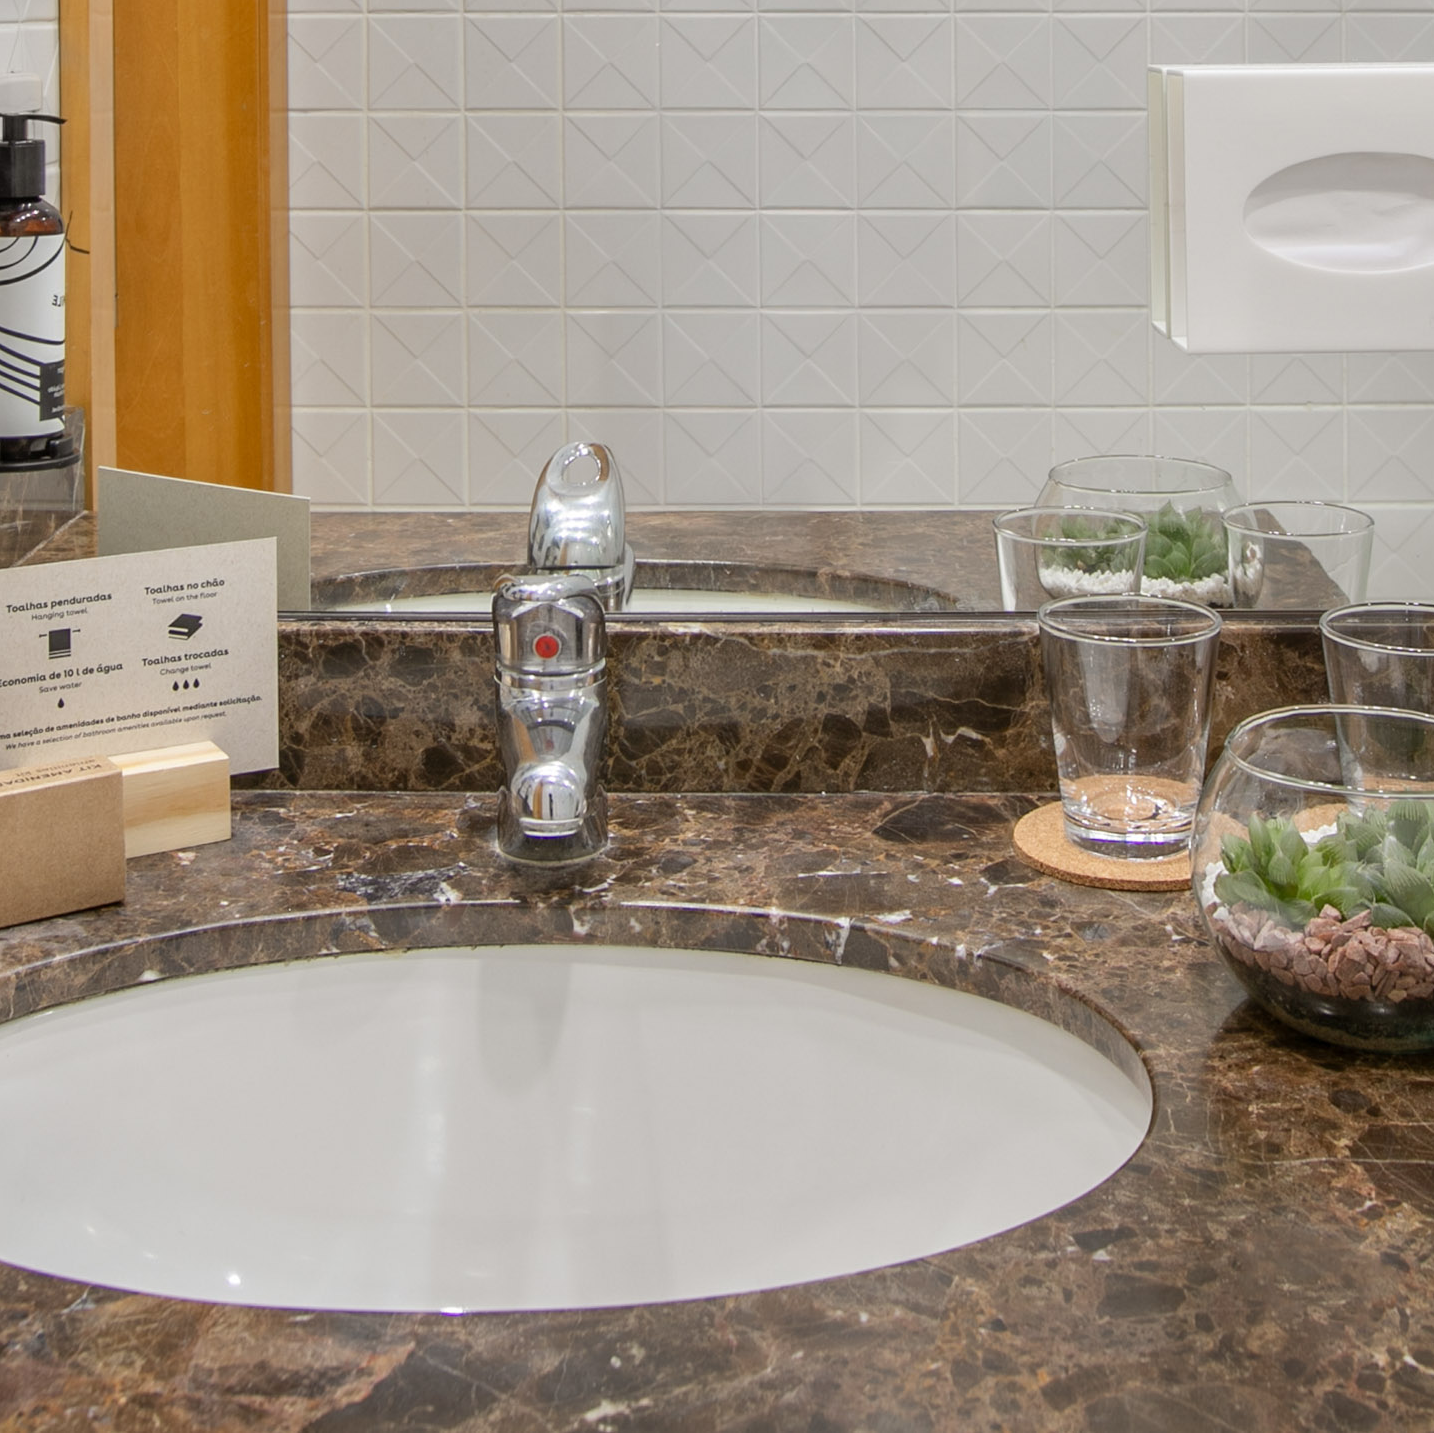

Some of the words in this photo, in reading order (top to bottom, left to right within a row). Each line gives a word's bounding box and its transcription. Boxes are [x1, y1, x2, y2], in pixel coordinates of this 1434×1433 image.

[144, 584, 184, 595] Toalhas
[186, 582, 199, 590] no
[200, 578, 225, 588] chão
[6, 601, 48, 613] Toalhas
[50, 593, 112, 609] penduradas
[152, 596, 174, 605] Towel
[31, 611, 65, 620] Hanging
[66, 607, 88, 616] towel
[142, 655, 182, 666] Toalhas
[184, 649, 229, 661] trocadas
[49, 671, 62, 680] de
[63, 669, 74, 678] 10
[82, 666, 94, 675] de
[96, 663, 123, 674] água
[160, 666, 189, 676] Change
[39, 685, 57, 693] Save
[59, 682, 82, 690] water
[13, 727, 44, 738] seleção
[45, 725, 55, 733] de
[56, 718, 104, 731] amenidades
[105, 716, 115, 724] de
[116, 712, 141, 722] banho
[142, 706, 180, 718] disponível
[182, 701, 218, 712] mediante
